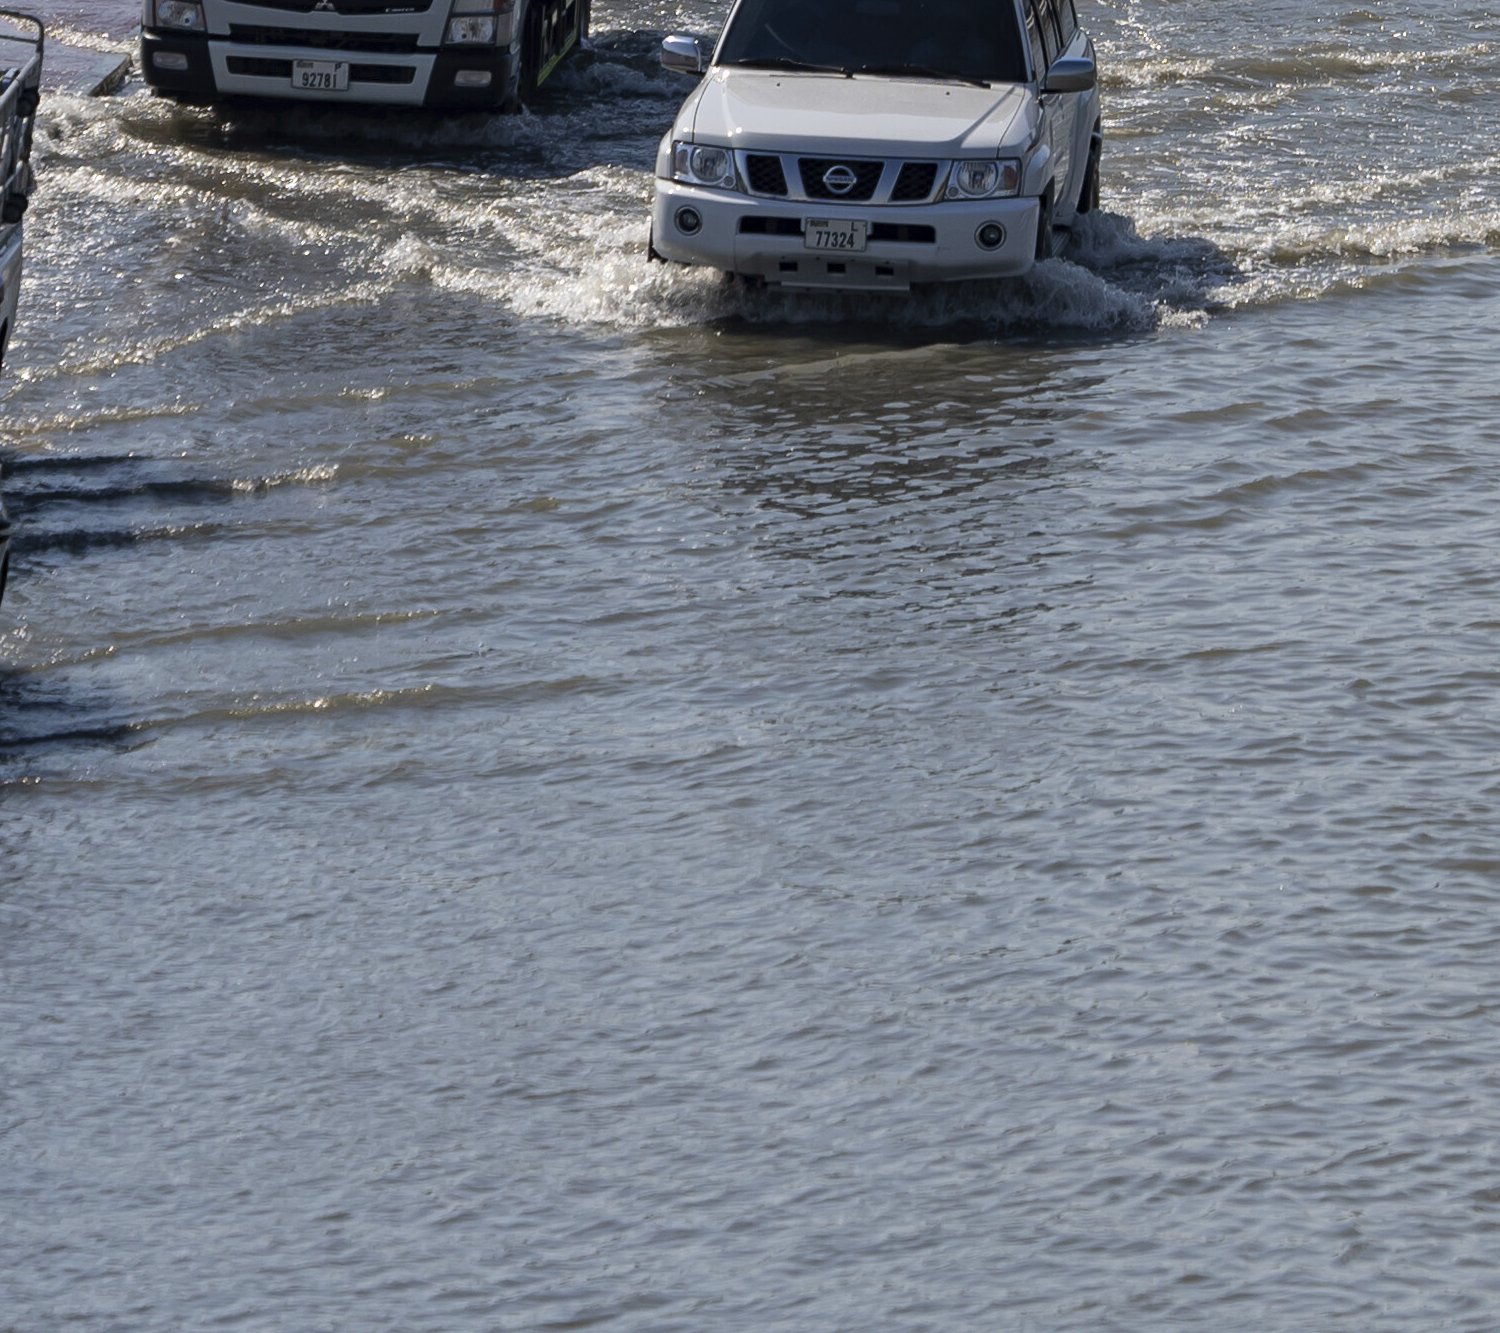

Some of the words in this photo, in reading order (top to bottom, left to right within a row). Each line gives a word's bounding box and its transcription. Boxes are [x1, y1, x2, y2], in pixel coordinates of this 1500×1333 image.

[334, 62, 342, 72] P
[301, 73, 338, 89] 92781
[851, 221, 858, 231] L
[815, 231, 855, 248] 77324
